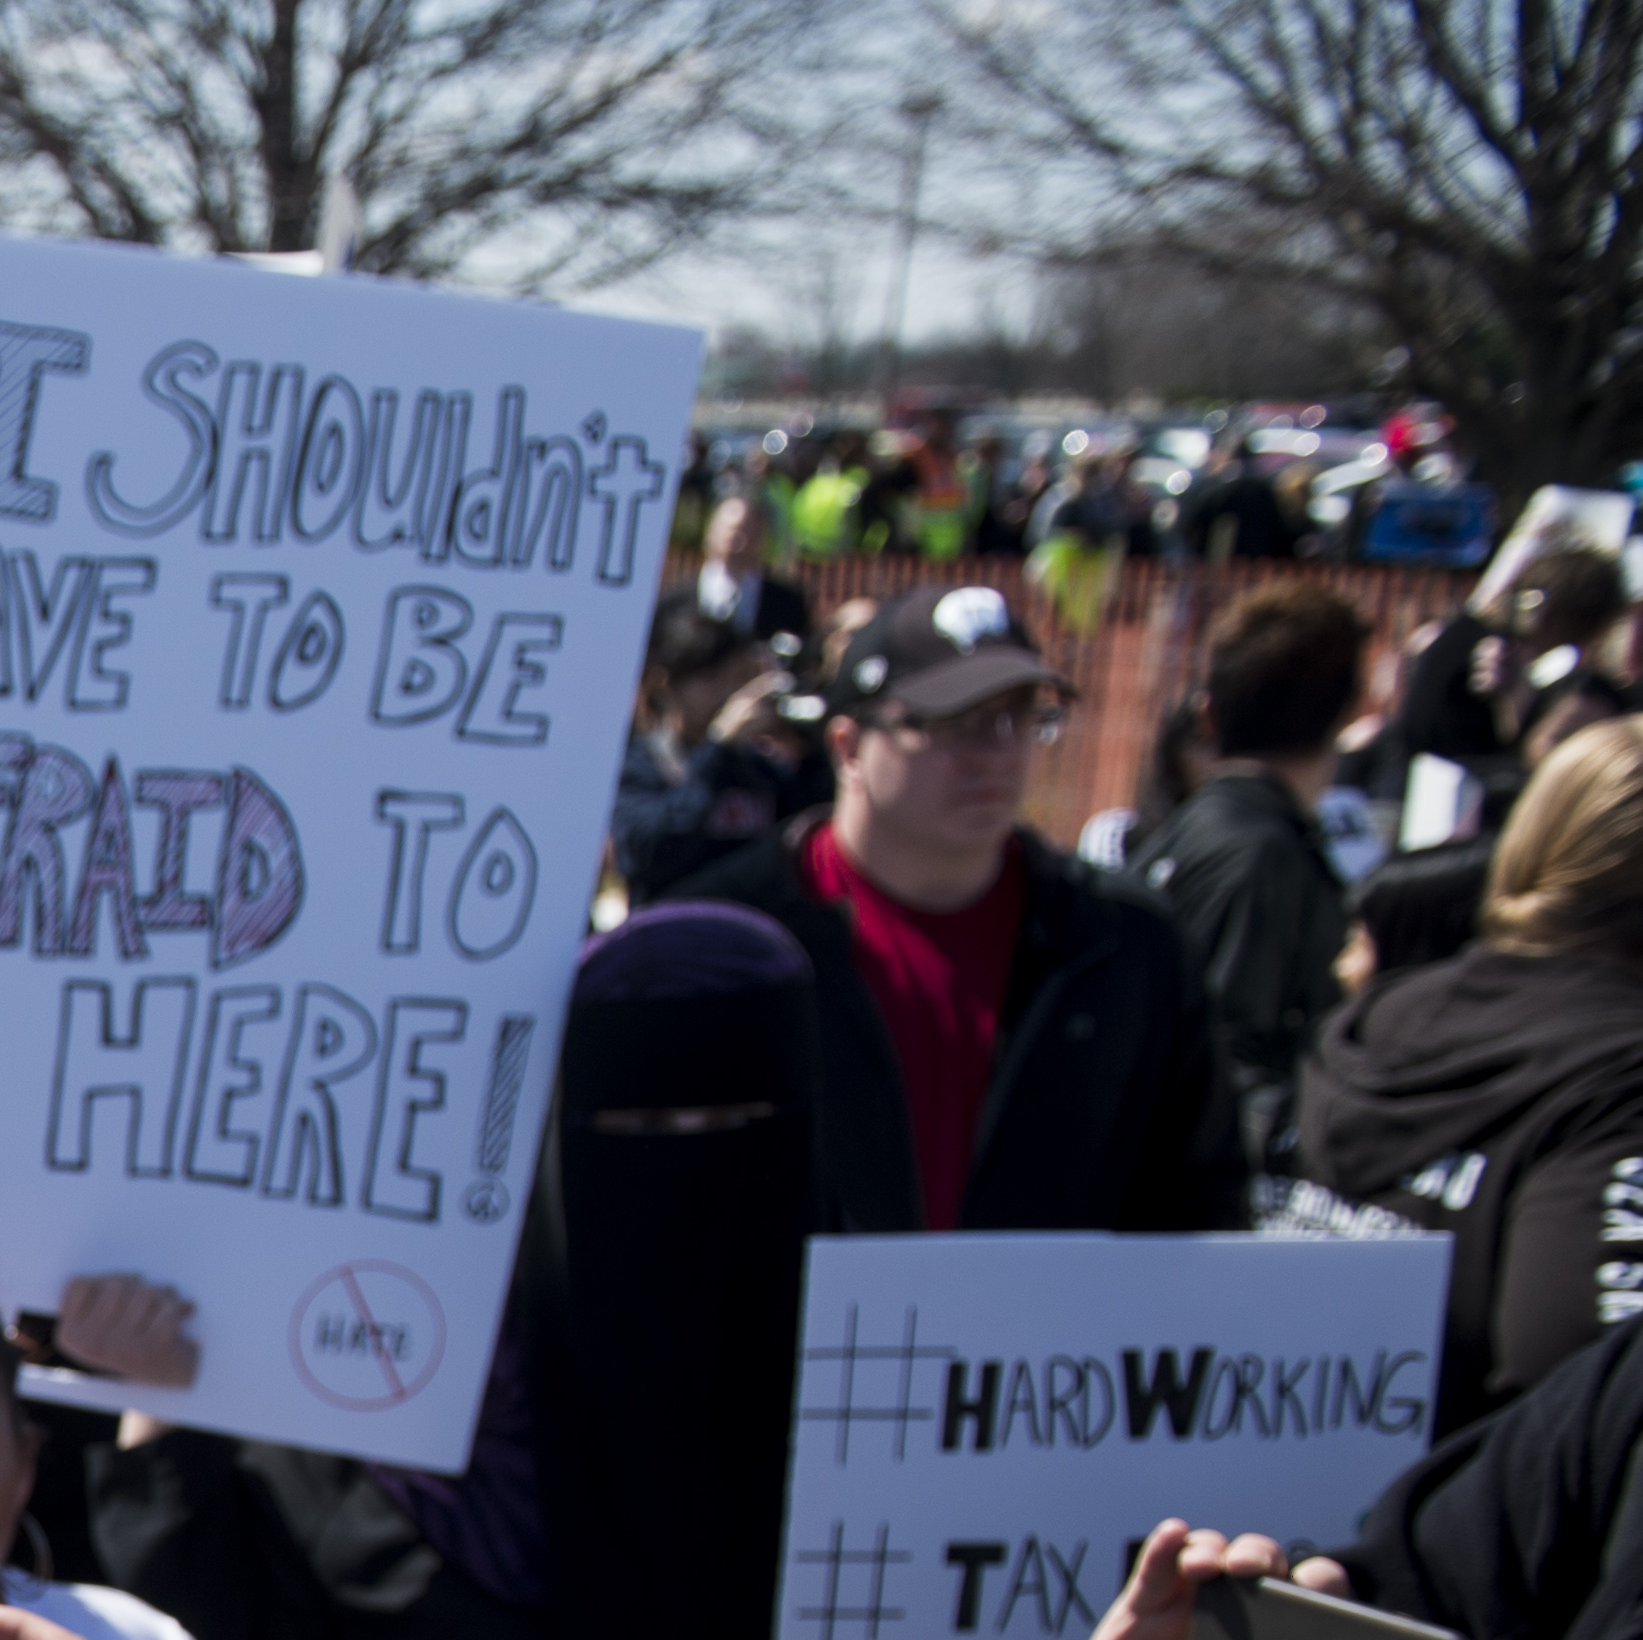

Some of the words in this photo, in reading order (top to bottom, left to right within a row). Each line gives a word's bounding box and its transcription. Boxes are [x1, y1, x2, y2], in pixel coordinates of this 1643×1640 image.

[211, 570, 345, 713] TO
[369, 583, 567, 748] BE
[375, 784, 539, 963] TO
[44, 974, 537, 1226] HERE!
